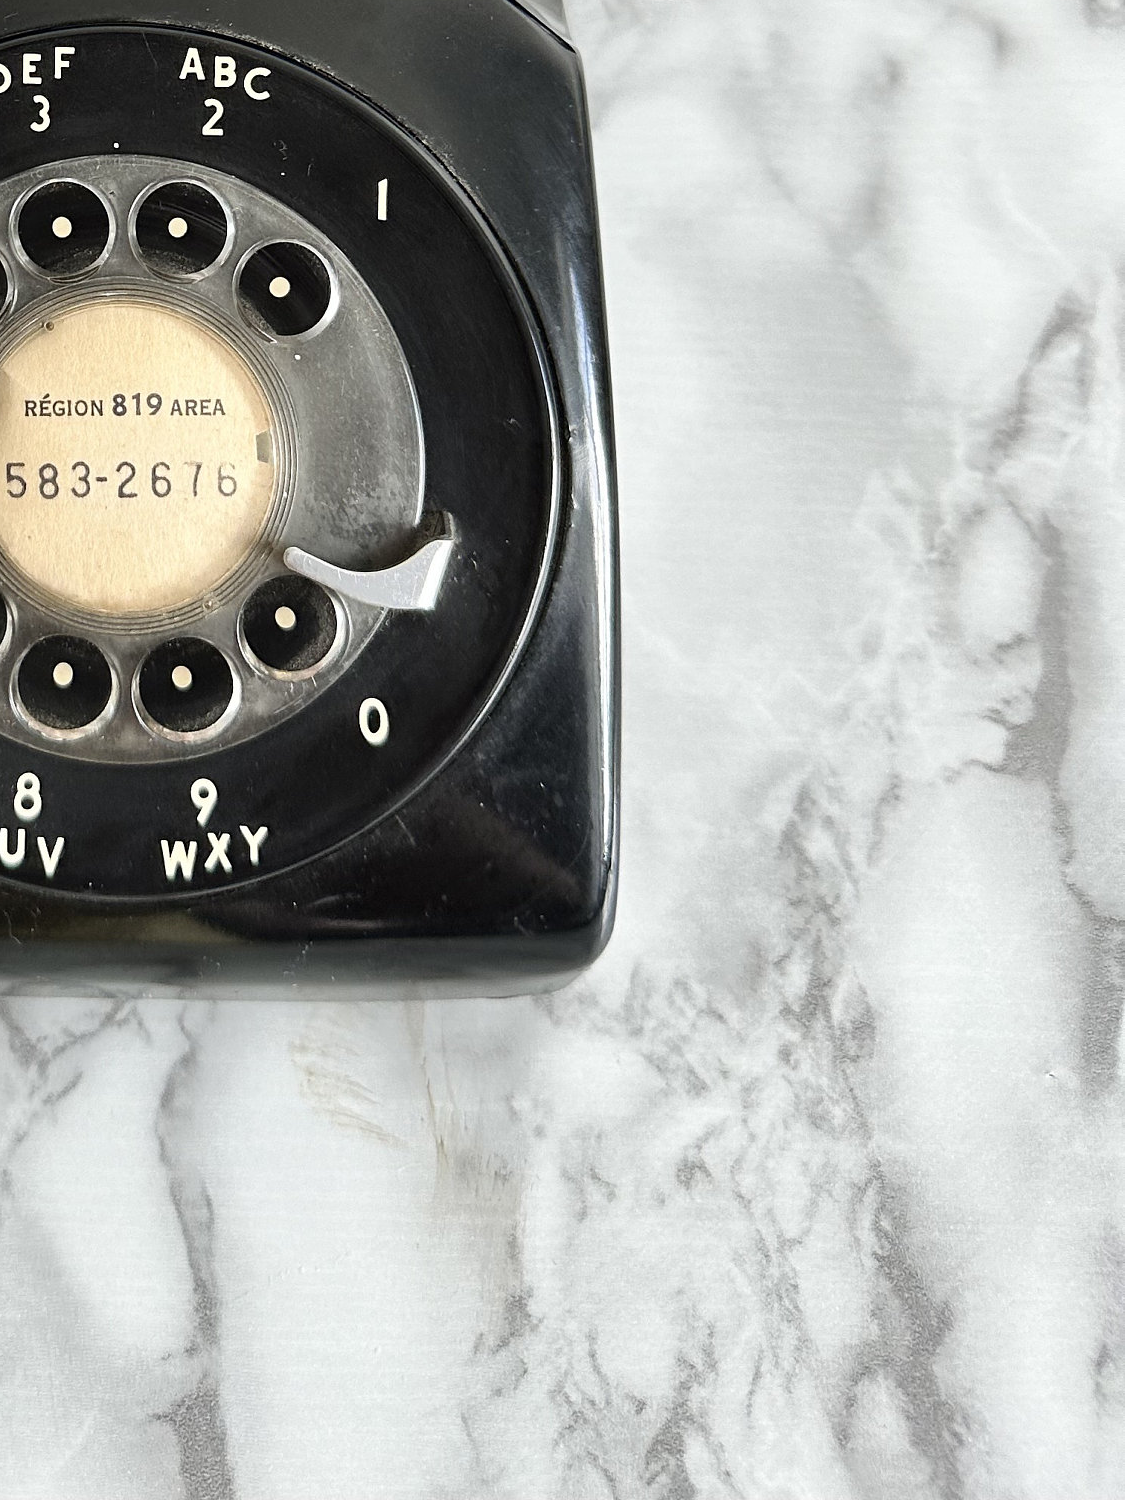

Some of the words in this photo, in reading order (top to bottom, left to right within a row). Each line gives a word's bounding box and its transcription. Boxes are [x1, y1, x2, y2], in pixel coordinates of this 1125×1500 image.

[178, 47, 272, 101] ABC
[30, 94, 52, 132] 3
[201, 98, 225, 136] 2
[24, 393, 104, 418] RÉGION
[111, 393, 163, 416] 819
[170, 398, 226, 416] AREA
[6, 461, 238, 499] 583-2676
[12, 772, 43, 821] 8
[189, 778, 219, 828] 9
[160, 825, 269, 881] WXY
